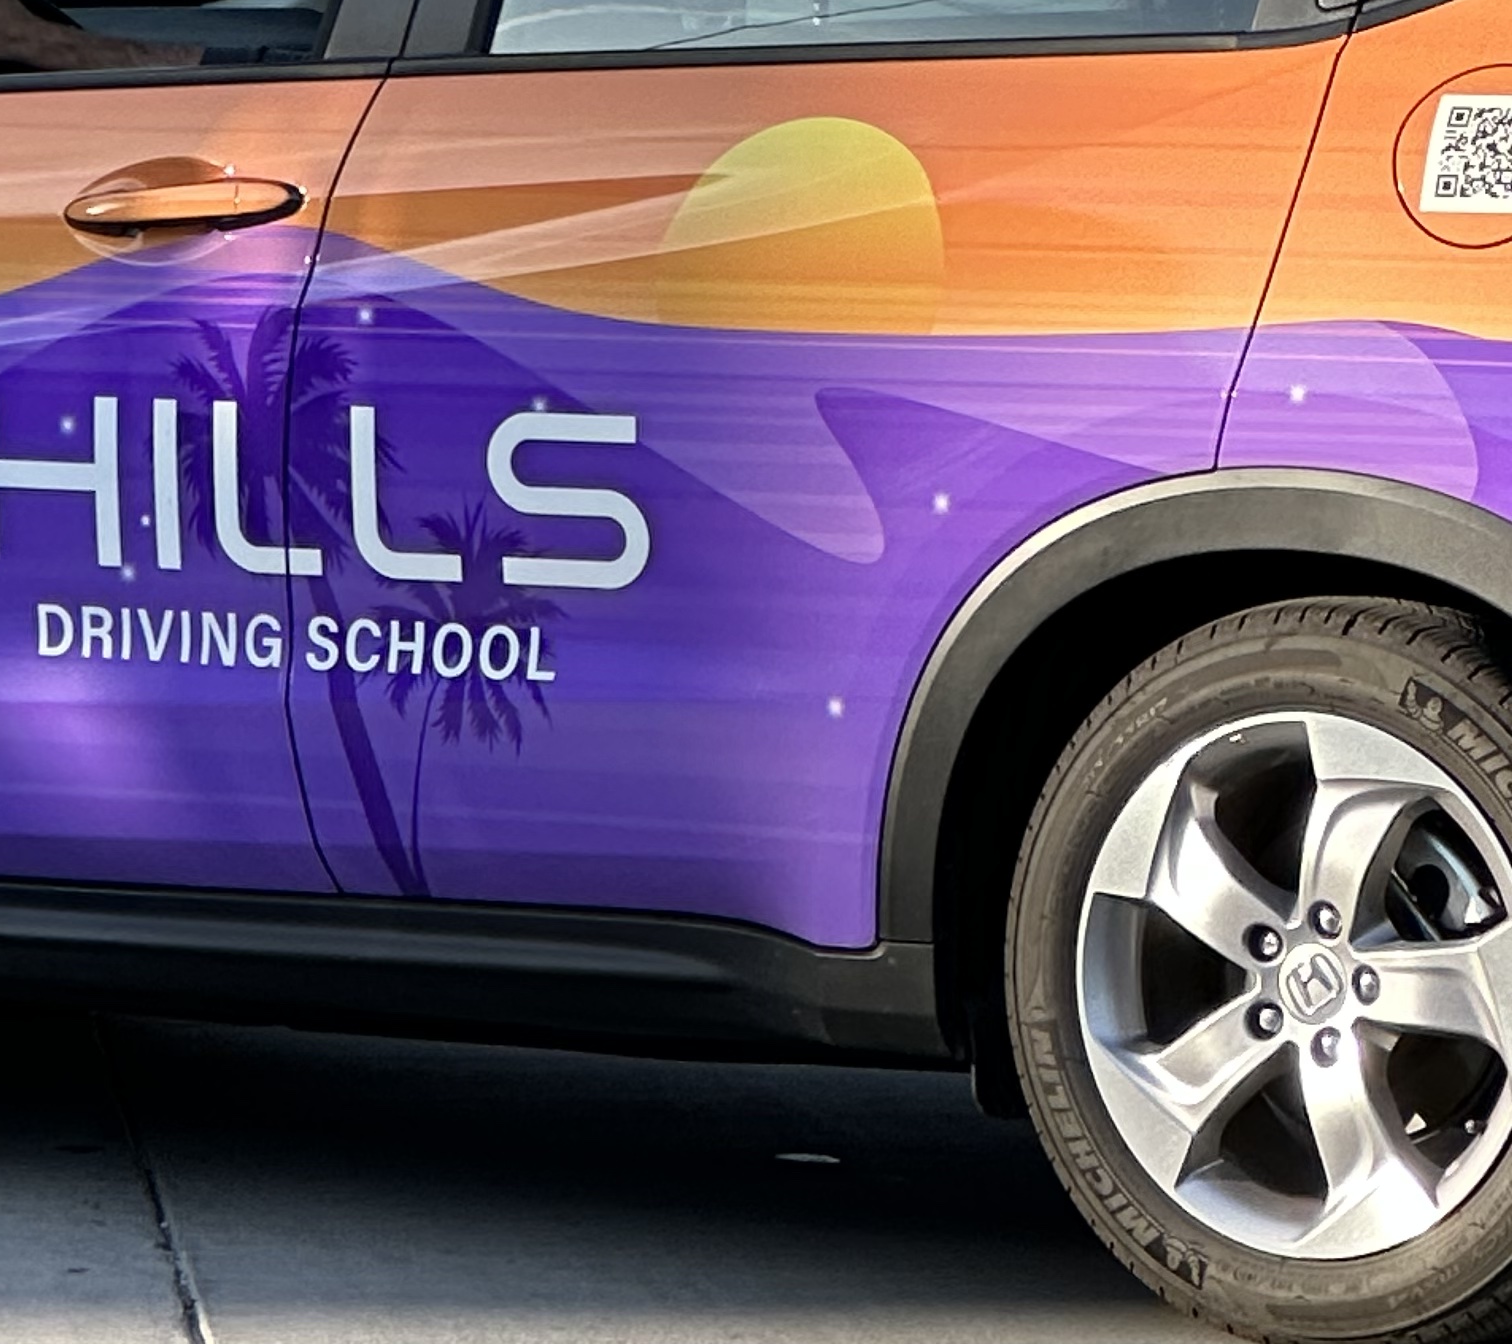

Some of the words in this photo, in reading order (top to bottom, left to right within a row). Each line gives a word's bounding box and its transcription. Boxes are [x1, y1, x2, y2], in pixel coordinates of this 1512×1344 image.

[36, 603, 283, 668] DRIVING
[305, 615, 556, 682] SCHOOL
[1030, 1024, 1161, 1247] MICHELIN
